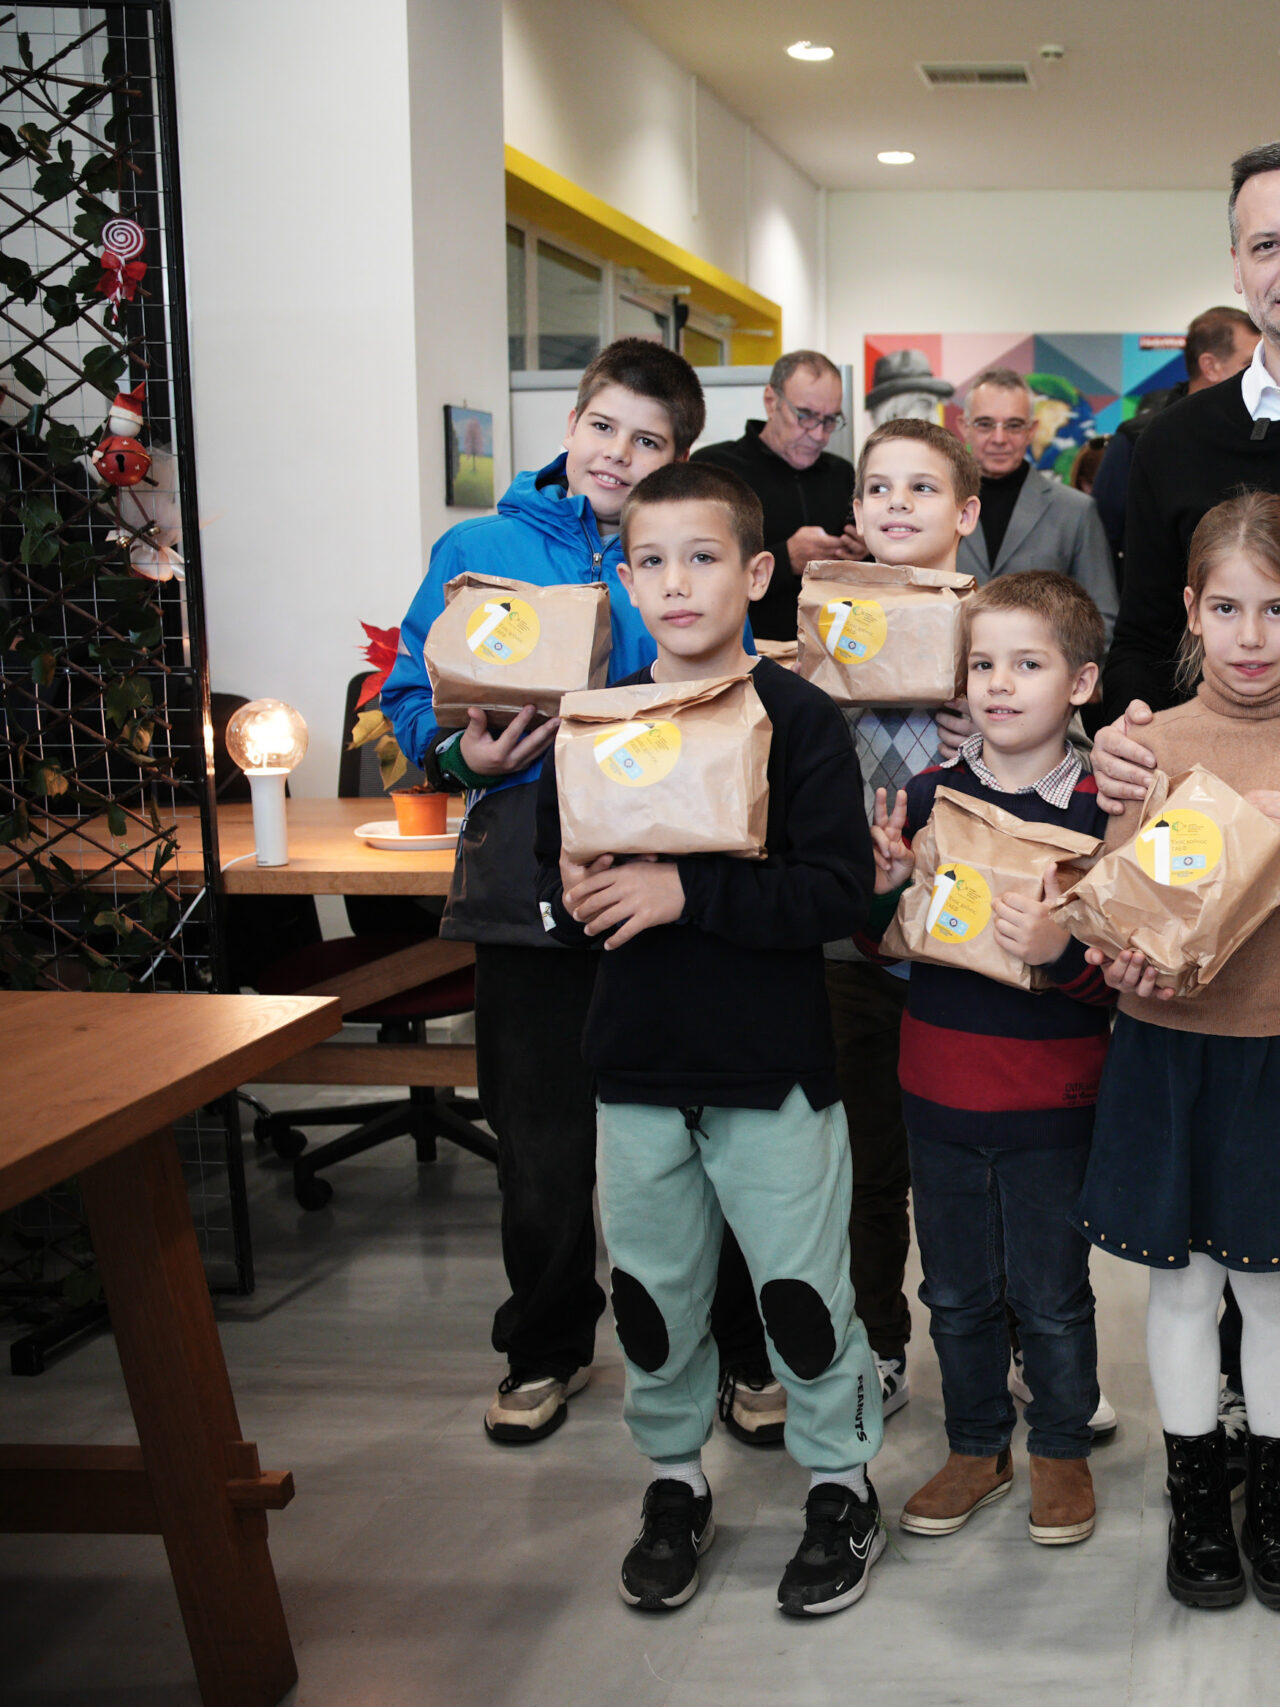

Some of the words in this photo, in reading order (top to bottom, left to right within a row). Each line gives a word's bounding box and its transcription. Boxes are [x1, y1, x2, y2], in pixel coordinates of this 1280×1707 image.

[467, 603, 509, 652] 1
[826, 603, 852, 656] 1
[1141, 827, 1170, 887] 1
[855, 1374, 867, 1442] PEANUTS
